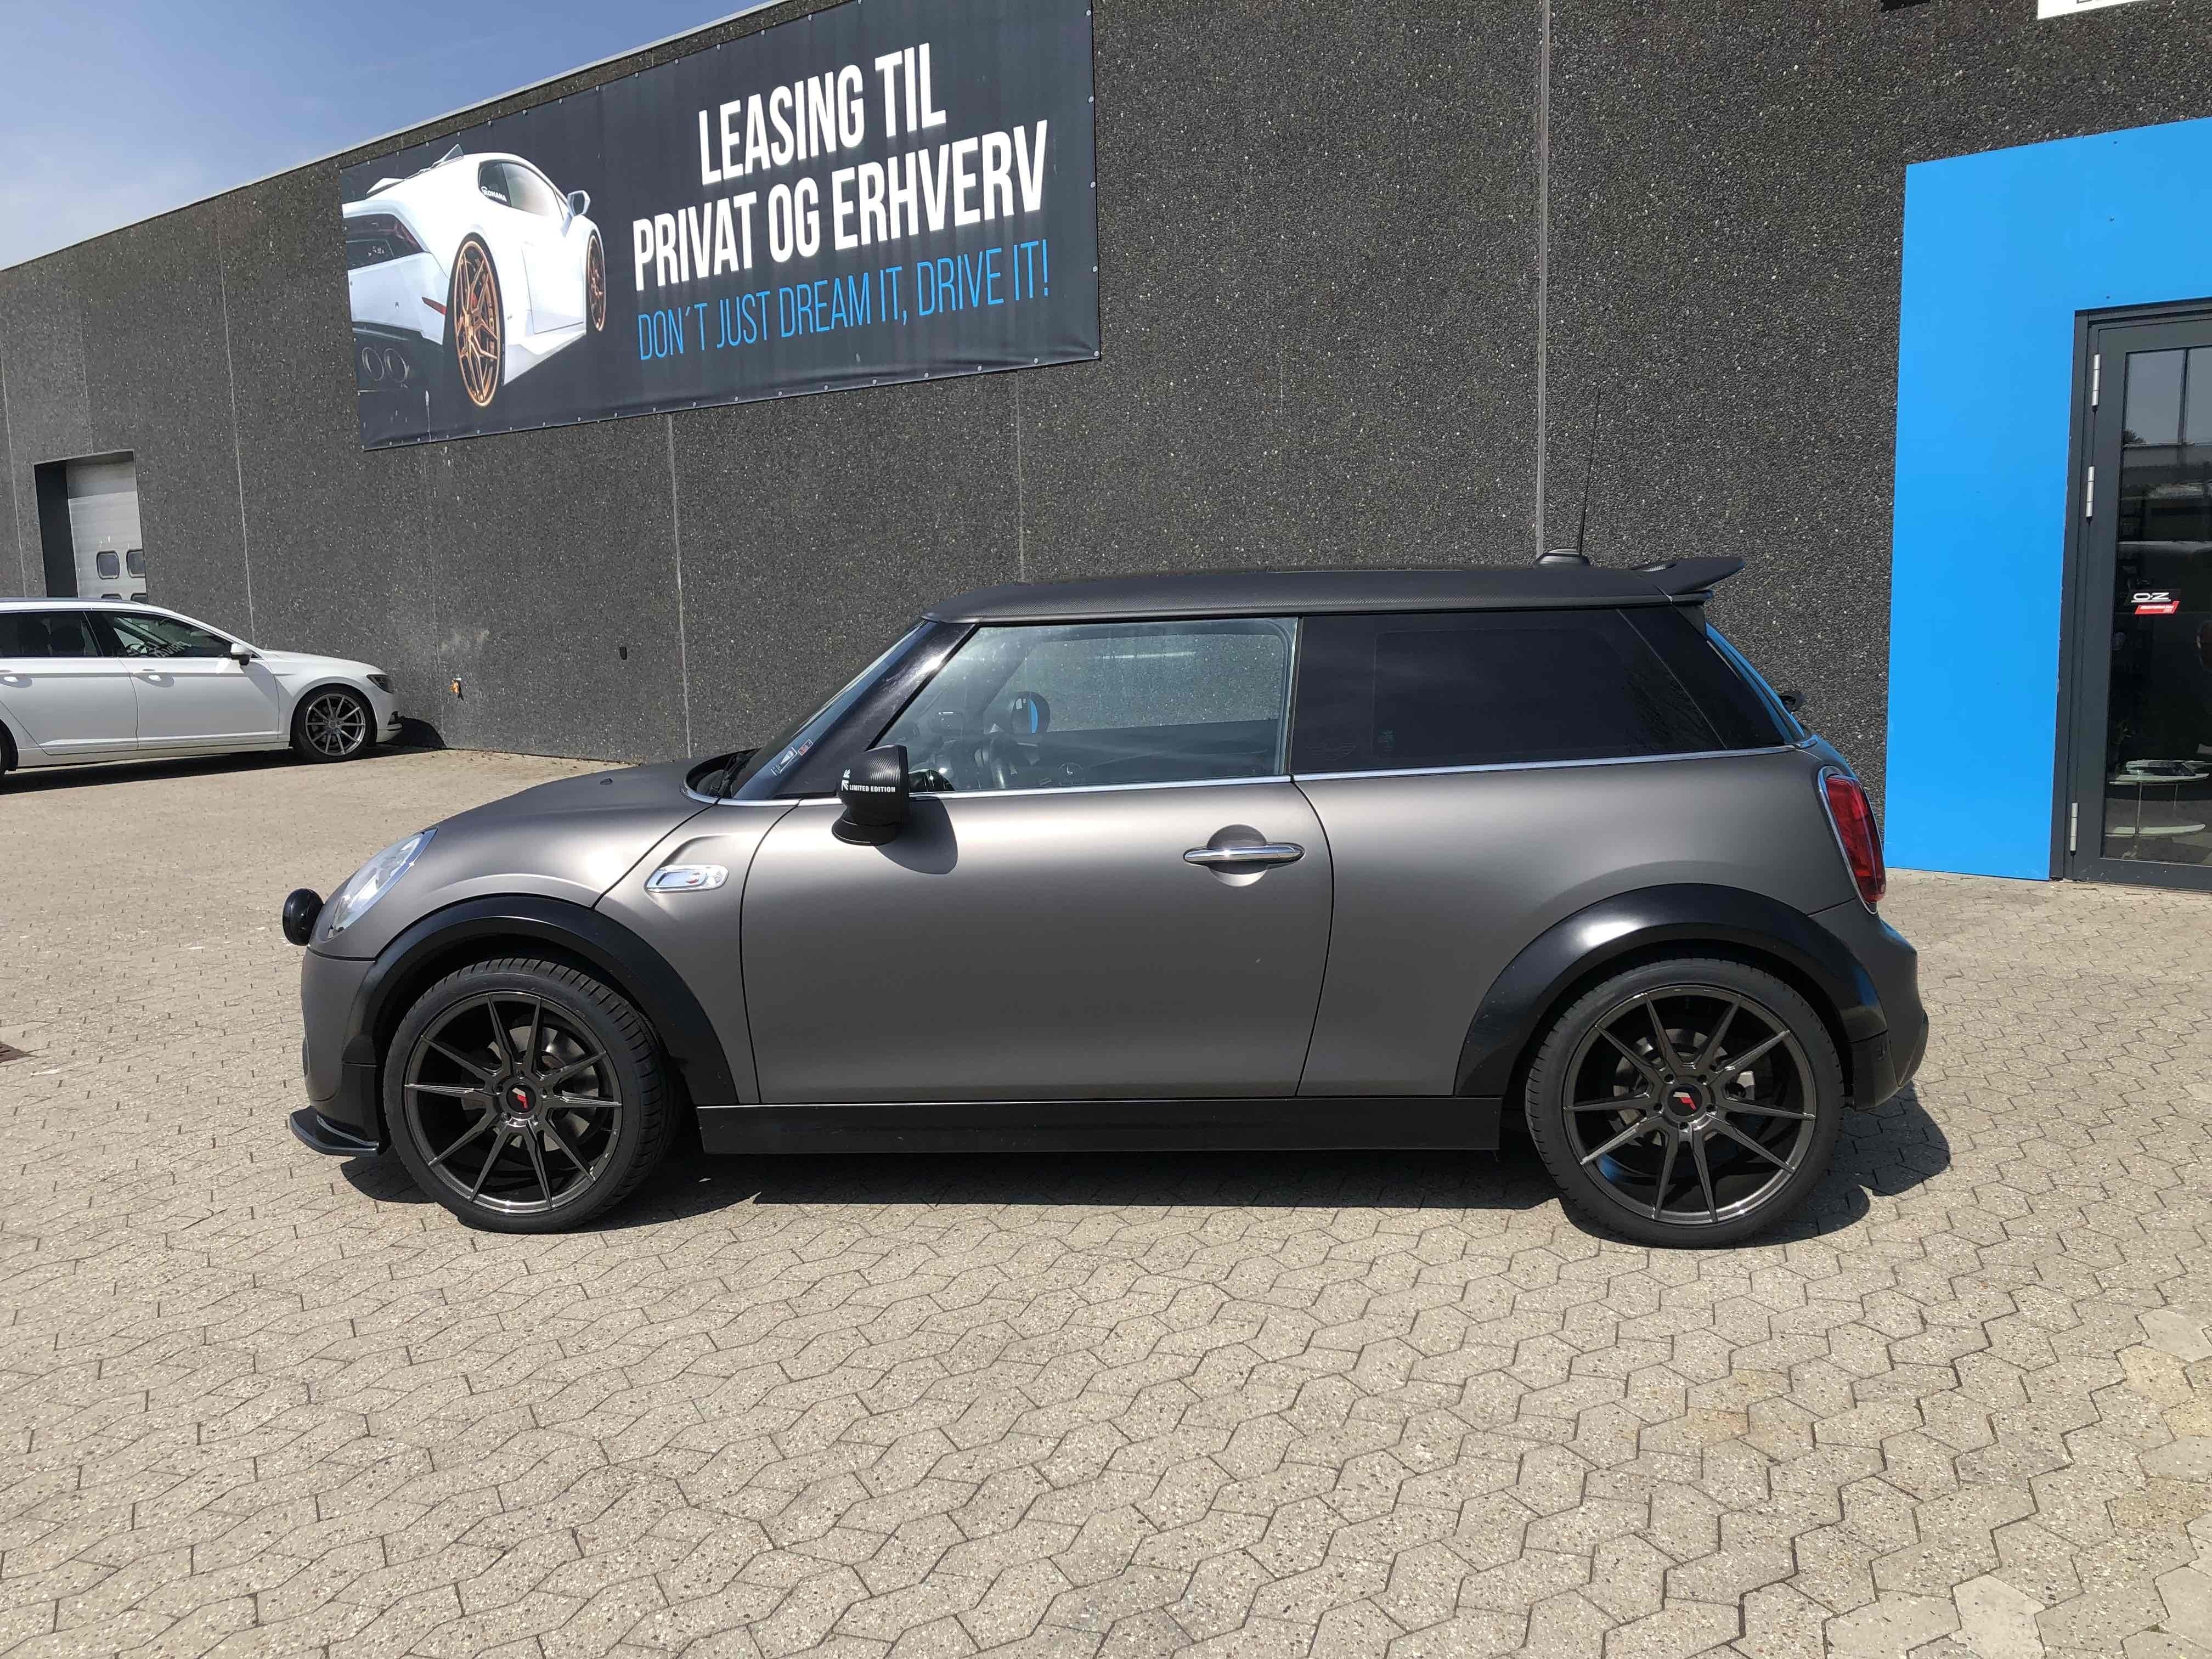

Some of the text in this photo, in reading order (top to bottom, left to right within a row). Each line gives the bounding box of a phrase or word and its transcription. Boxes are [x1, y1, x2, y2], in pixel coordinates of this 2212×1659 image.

[698, 42, 946, 186] LEASING TIL
[633, 119, 1048, 291] PRIVAT OG ERHVERV
[716, 291, 771, 348] JUST
[779, 272, 871, 338] DREAM
[879, 266, 907, 325] IT,
[917, 247, 1005, 317] DRIVE
[1013, 239, 1051, 302] IT!
[849, 784, 870, 792] LIMITED
